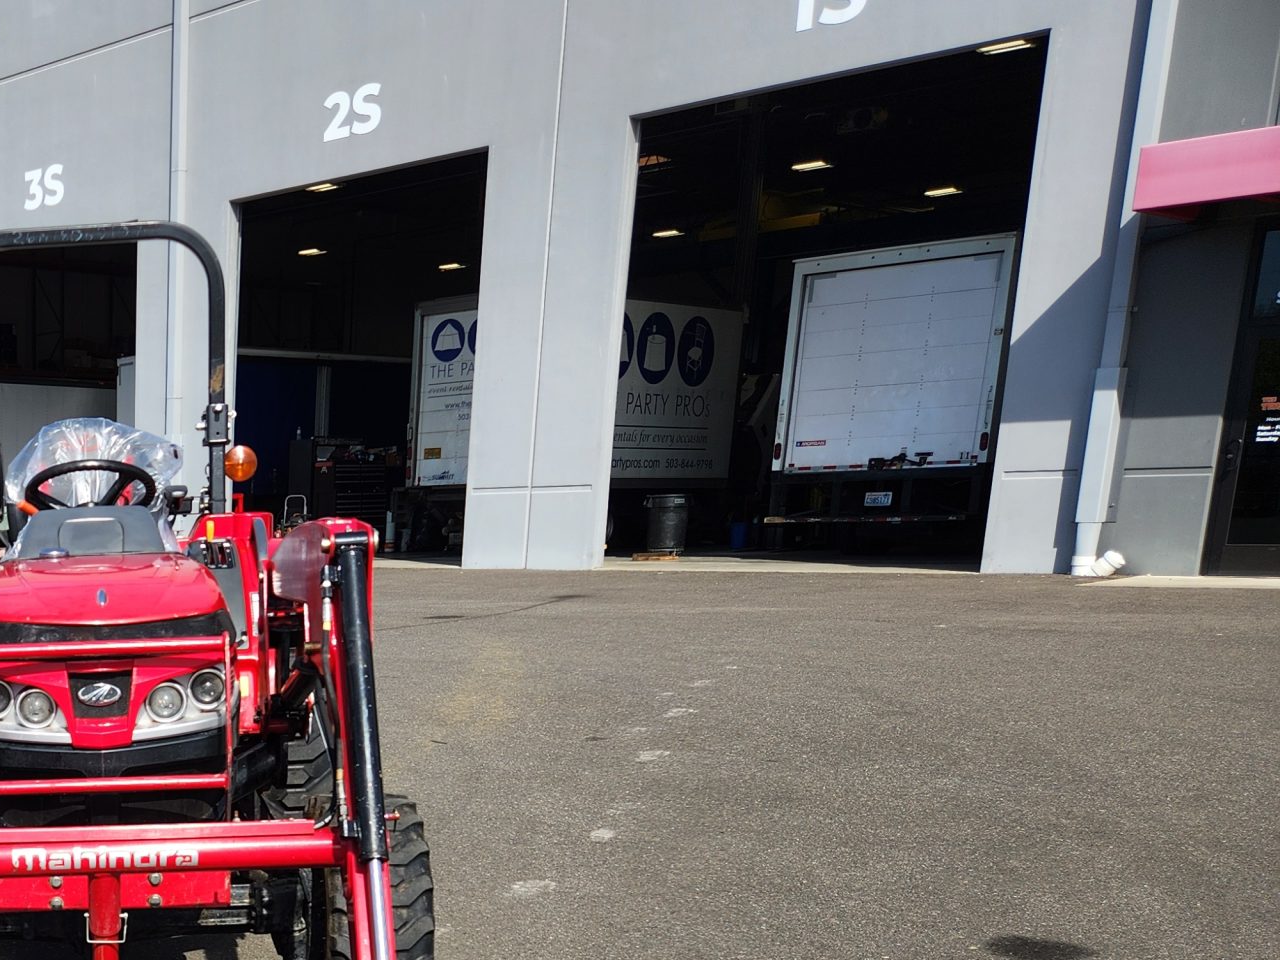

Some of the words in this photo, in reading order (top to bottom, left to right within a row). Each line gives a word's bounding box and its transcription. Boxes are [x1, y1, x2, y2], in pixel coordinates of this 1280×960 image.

[323, 82, 381, 143] 2S
[23, 163, 65, 211] 3S
[430, 363, 454, 379] THE
[625, 391, 670, 416] PARTY
[638, 429, 652, 446] for
